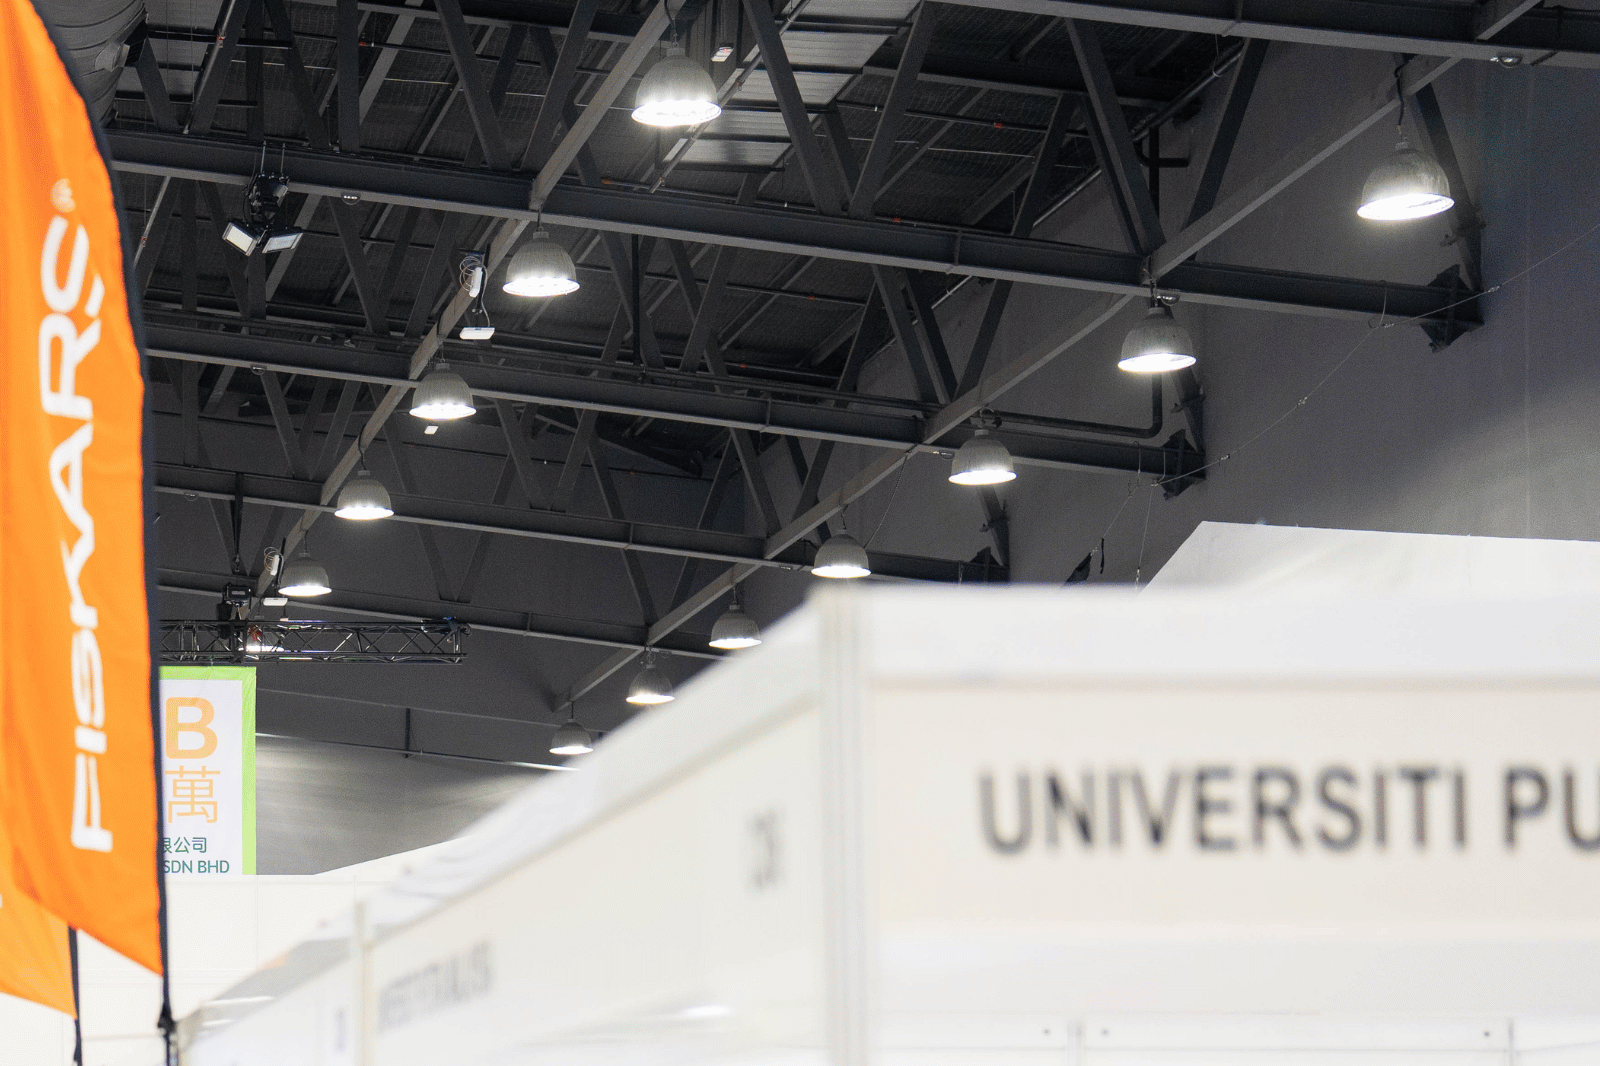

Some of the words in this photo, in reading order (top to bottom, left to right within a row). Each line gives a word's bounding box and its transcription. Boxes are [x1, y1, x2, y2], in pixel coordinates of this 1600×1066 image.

[38, 214, 114, 854] FISKARS
[164, 765, 221, 824] 萬
[978, 764, 1470, 857] UNIVERSITI
[163, 860, 193, 874] SDN
[197, 860, 230, 874] BHD
